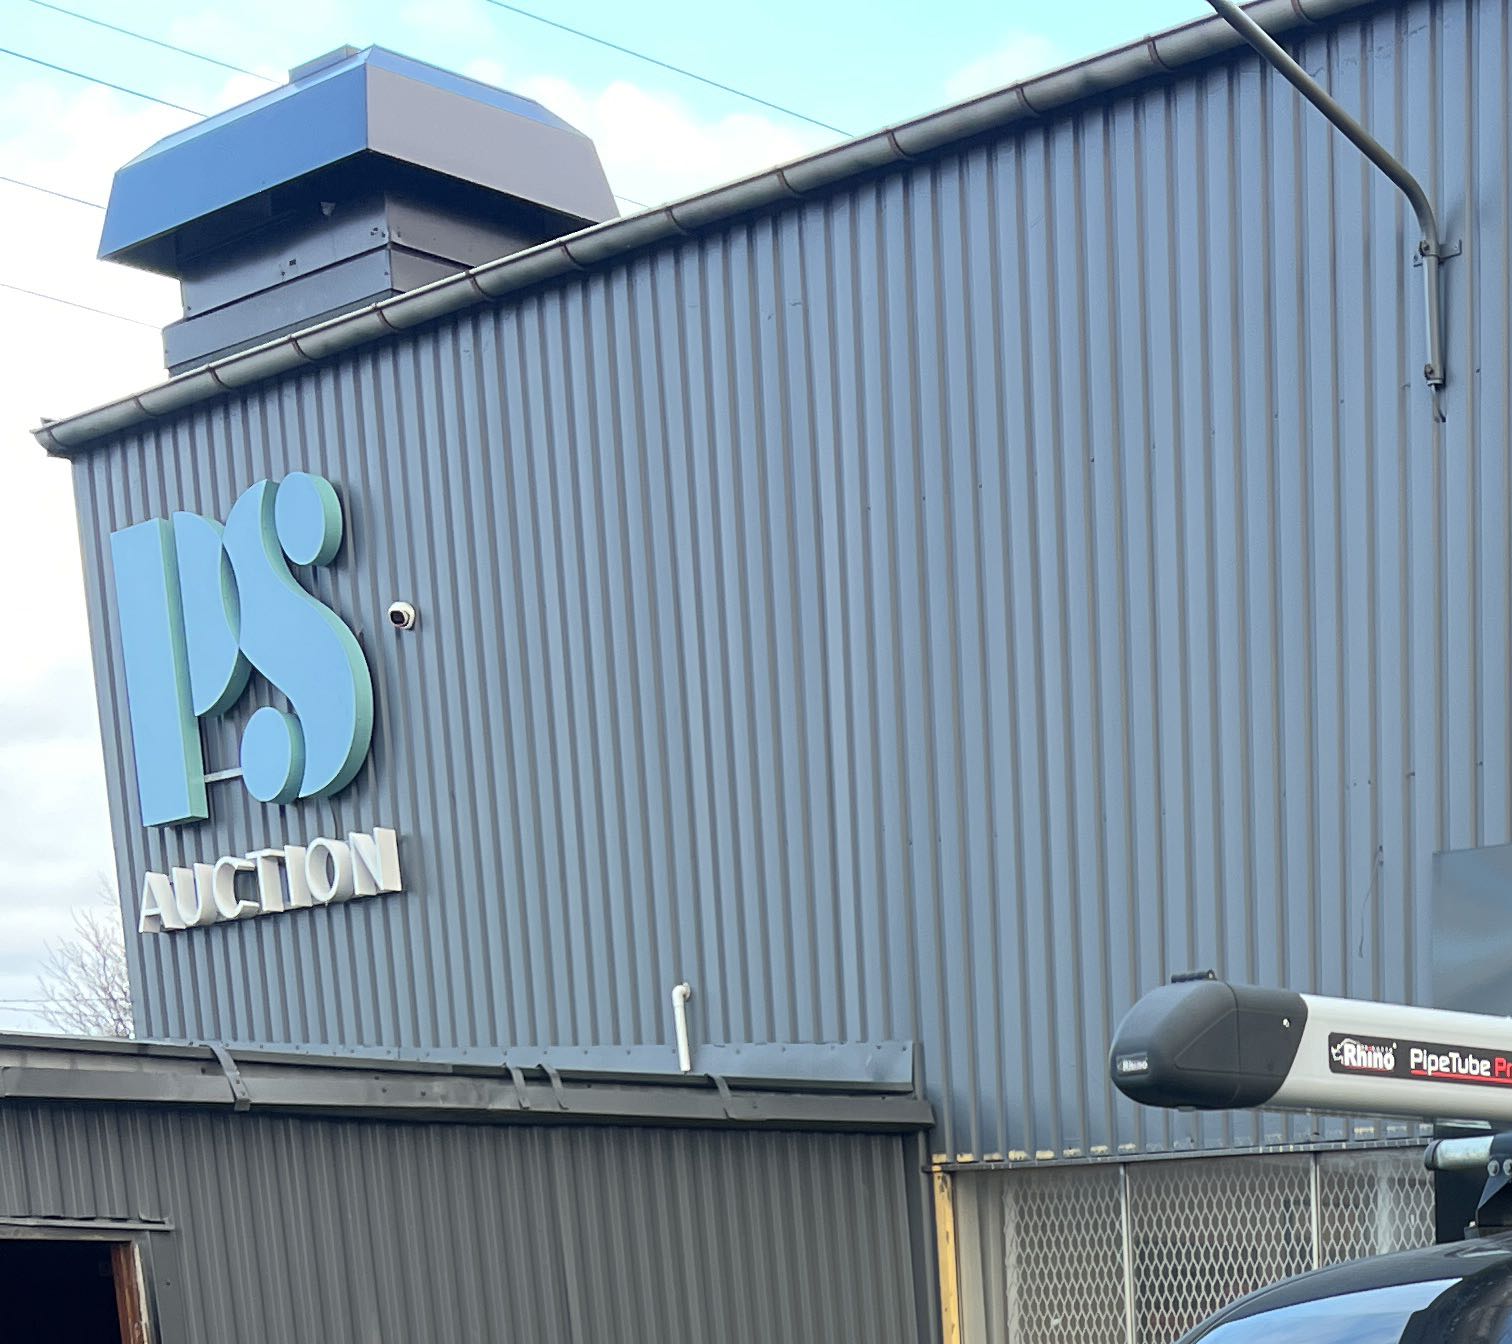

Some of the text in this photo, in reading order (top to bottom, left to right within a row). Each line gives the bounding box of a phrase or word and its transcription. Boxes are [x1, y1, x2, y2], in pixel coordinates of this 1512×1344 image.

[111, 471, 374, 827] PS
[139, 827, 402, 933] AUCTION
[1344, 1043, 1395, 1070] Rhino
[1410, 1048, 1490, 1076] PipeTube
